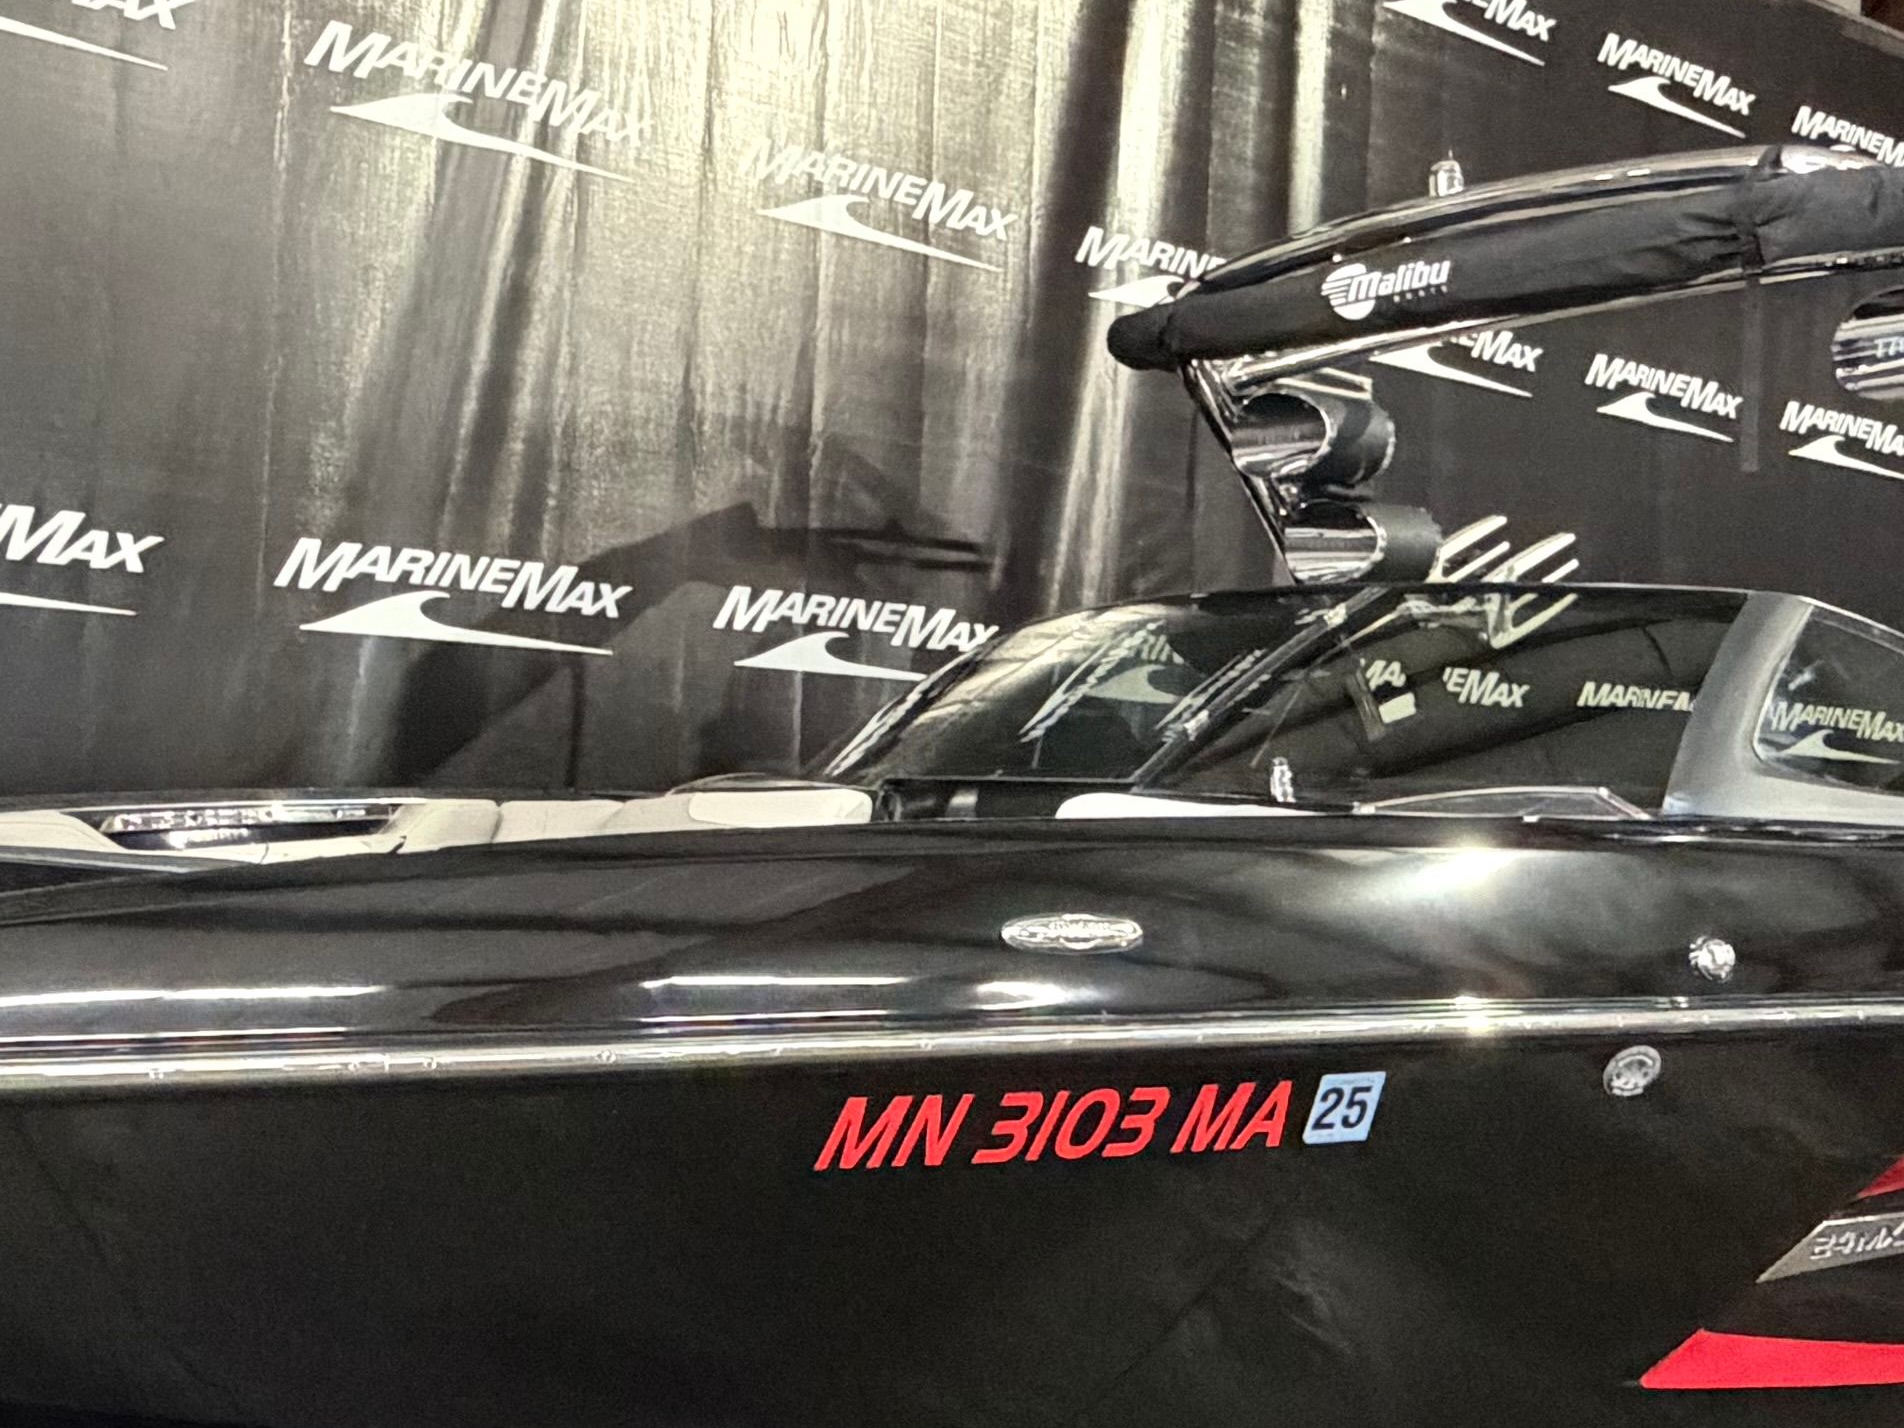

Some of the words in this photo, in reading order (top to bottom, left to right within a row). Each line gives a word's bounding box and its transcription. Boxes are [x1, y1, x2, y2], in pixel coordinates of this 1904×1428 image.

[813, 1093, 973, 1172] MN
[971, 1086, 1169, 1165] 3103
[1169, 1079, 1294, 1154] MA
[1310, 1084, 1375, 1132] 25
